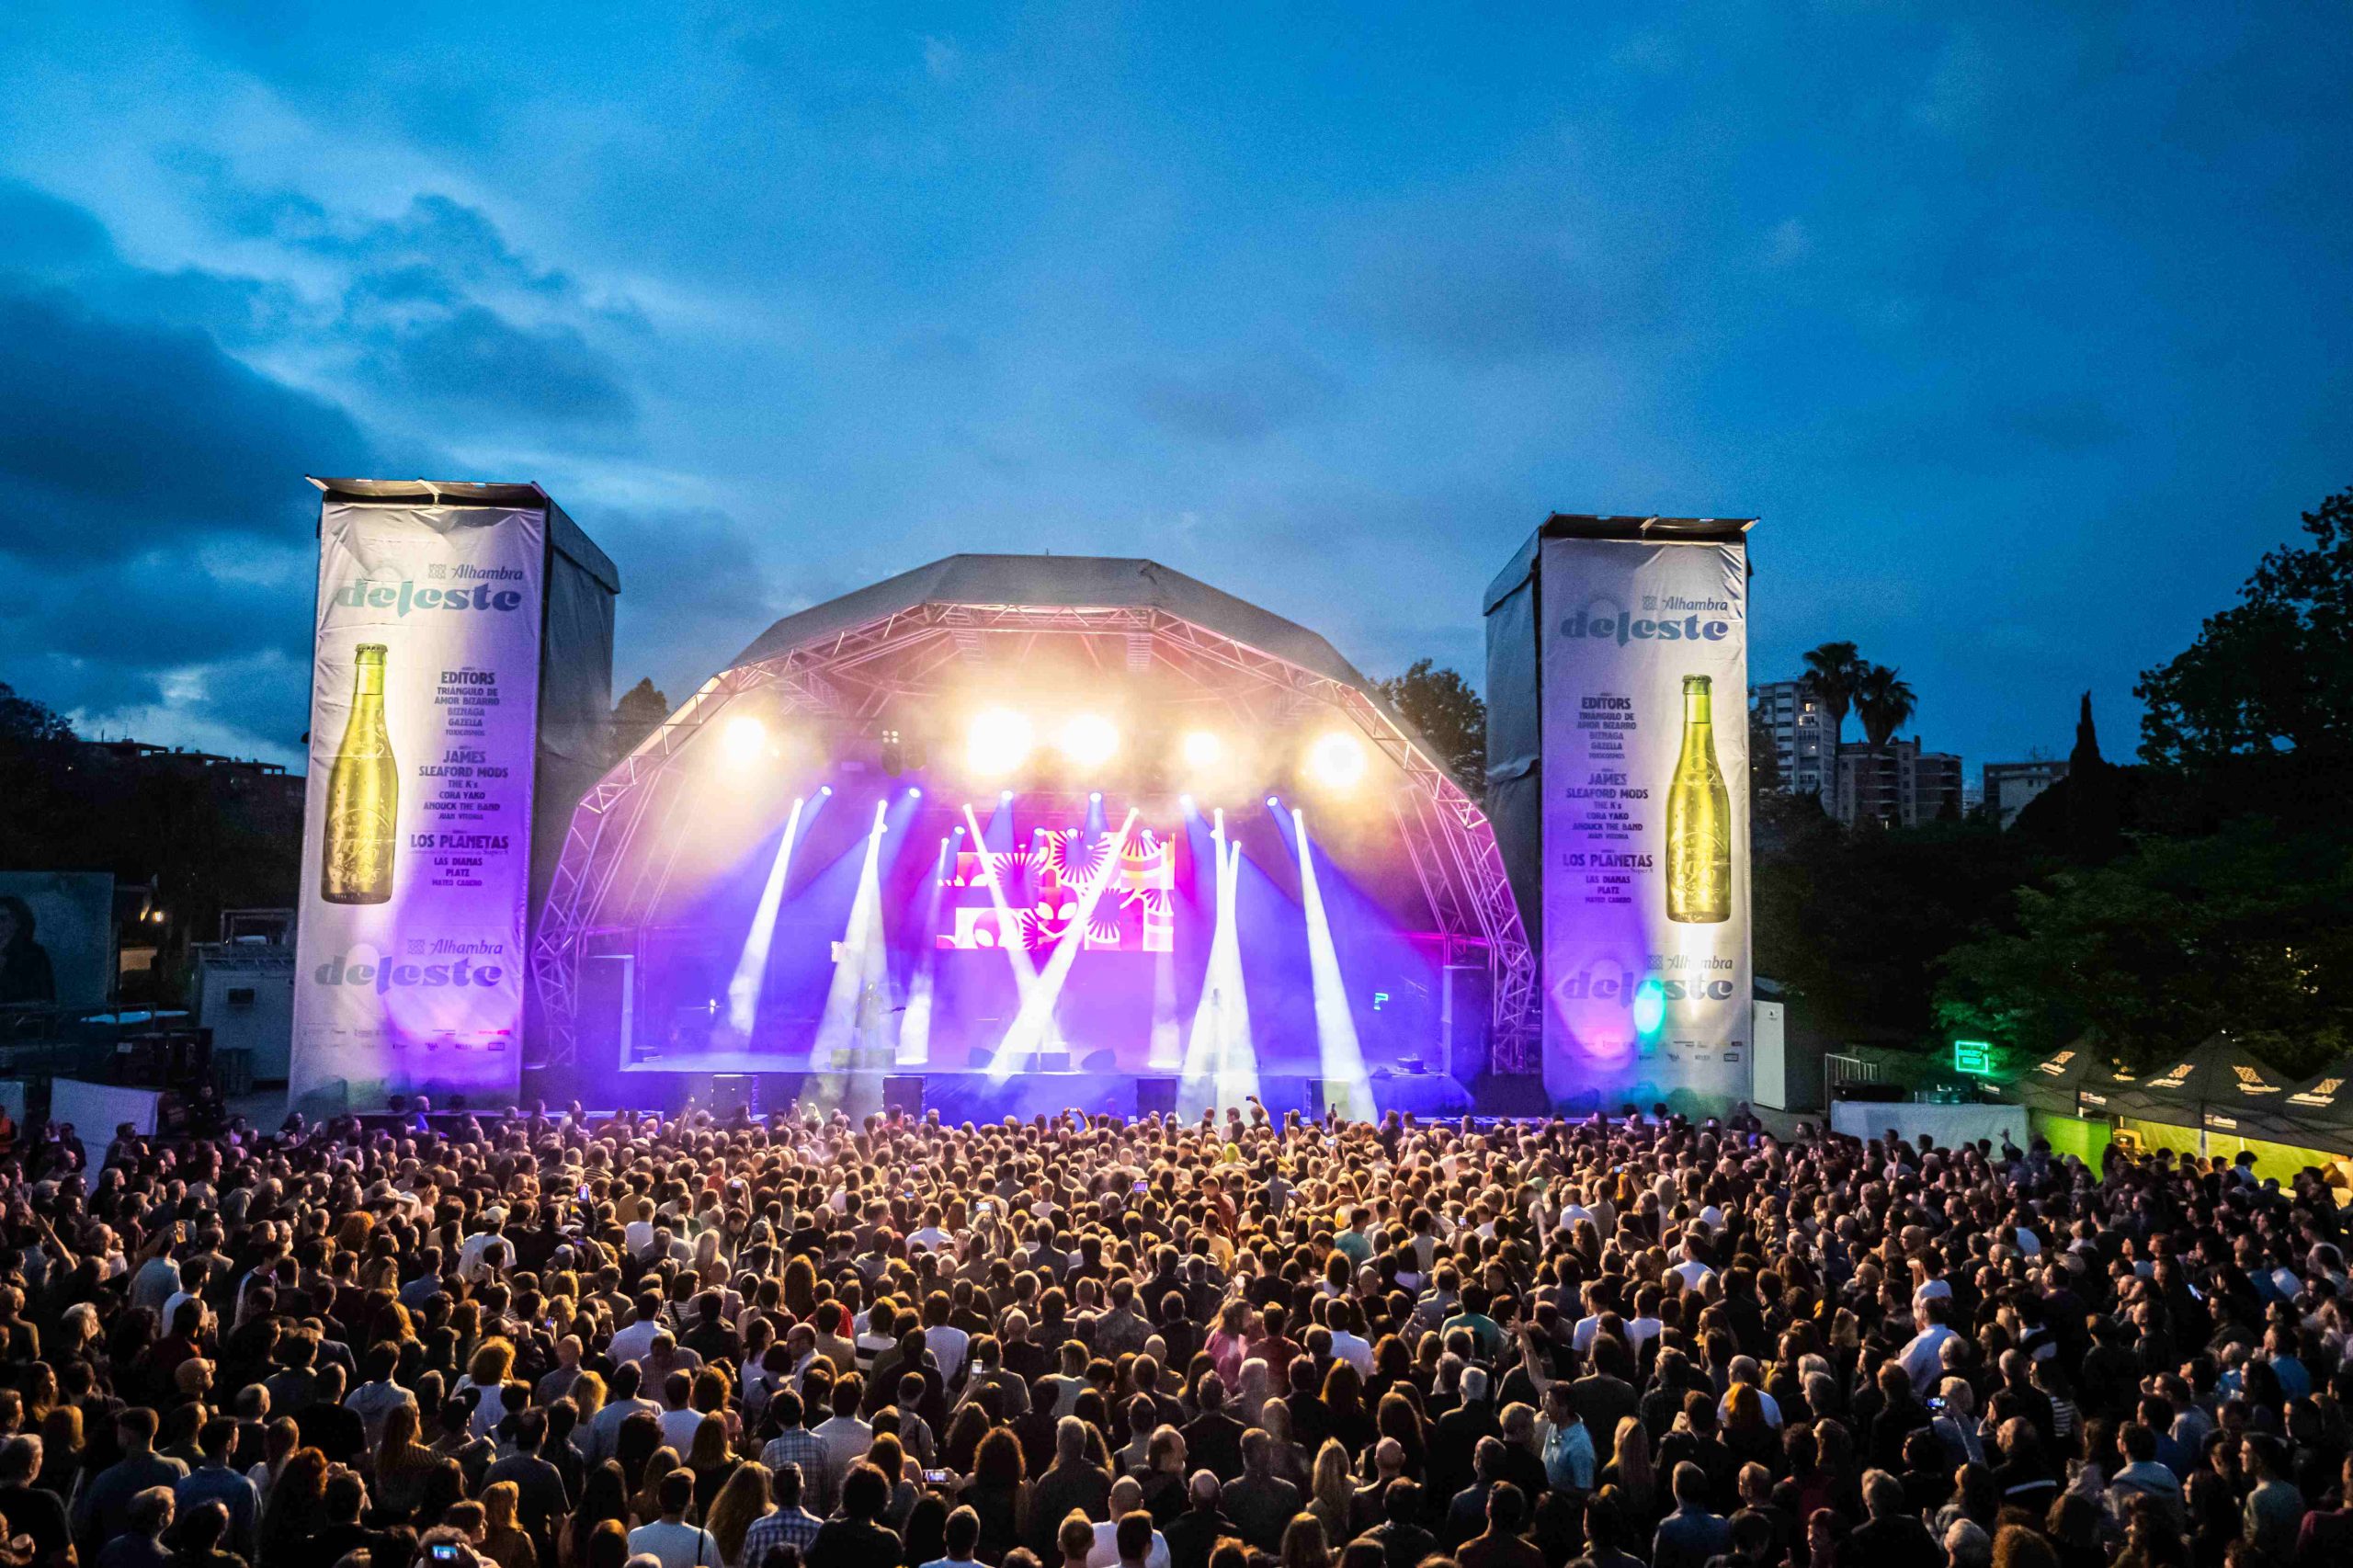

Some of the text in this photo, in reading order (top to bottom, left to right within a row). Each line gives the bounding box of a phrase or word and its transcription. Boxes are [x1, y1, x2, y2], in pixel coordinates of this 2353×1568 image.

[451, 563, 523, 581] Alhambra
[335, 578, 522, 618] deleste
[1662, 596, 1728, 612] Alhambra
[1561, 610, 1729, 648] deleste
[441, 671, 495, 685] EDITORS
[486, 687, 498, 697] DE
[434, 697, 500, 706] AMOR BIZARRO
[1581, 697, 1631, 710] EDITORS
[1624, 712, 1635, 721] DE
[448, 718, 483, 727] GAZELLA
[1576, 722, 1637, 730] AMOR BIZARRO
[1590, 742, 1623, 751] GAZELLA
[443, 750, 486, 764] JAMES
[418, 766, 509, 778] SLEAFORD MODS
[448, 779, 463, 789] THE
[1587, 773, 1627, 786] JAMES
[438, 790, 486, 800] CORA YAKO
[1566, 788, 1649, 800] SLEAFORD MODS
[423, 801, 501, 812] ANOUCK THE BAND
[1594, 801, 1608, 810] THE
[1586, 812, 1630, 821] CORA YAKO
[1606, 823, 1620, 831] THE
[1622, 824, 1643, 832] BAND
[410, 834, 509, 849] LOS PLANETAS
[434, 857, 483, 866] LAS DIANAS
[1563, 853, 1654, 868] LOS PLANETAS
[446, 869, 471, 877] PLATZ
[1586, 875, 1631, 884] LAS DIANAS
[1597, 886, 1620, 895] PLATZ
[429, 938, 504, 956] Alhambra
[1667, 954, 1733, 970] Alhmbra
[313, 955, 503, 995] deleste
